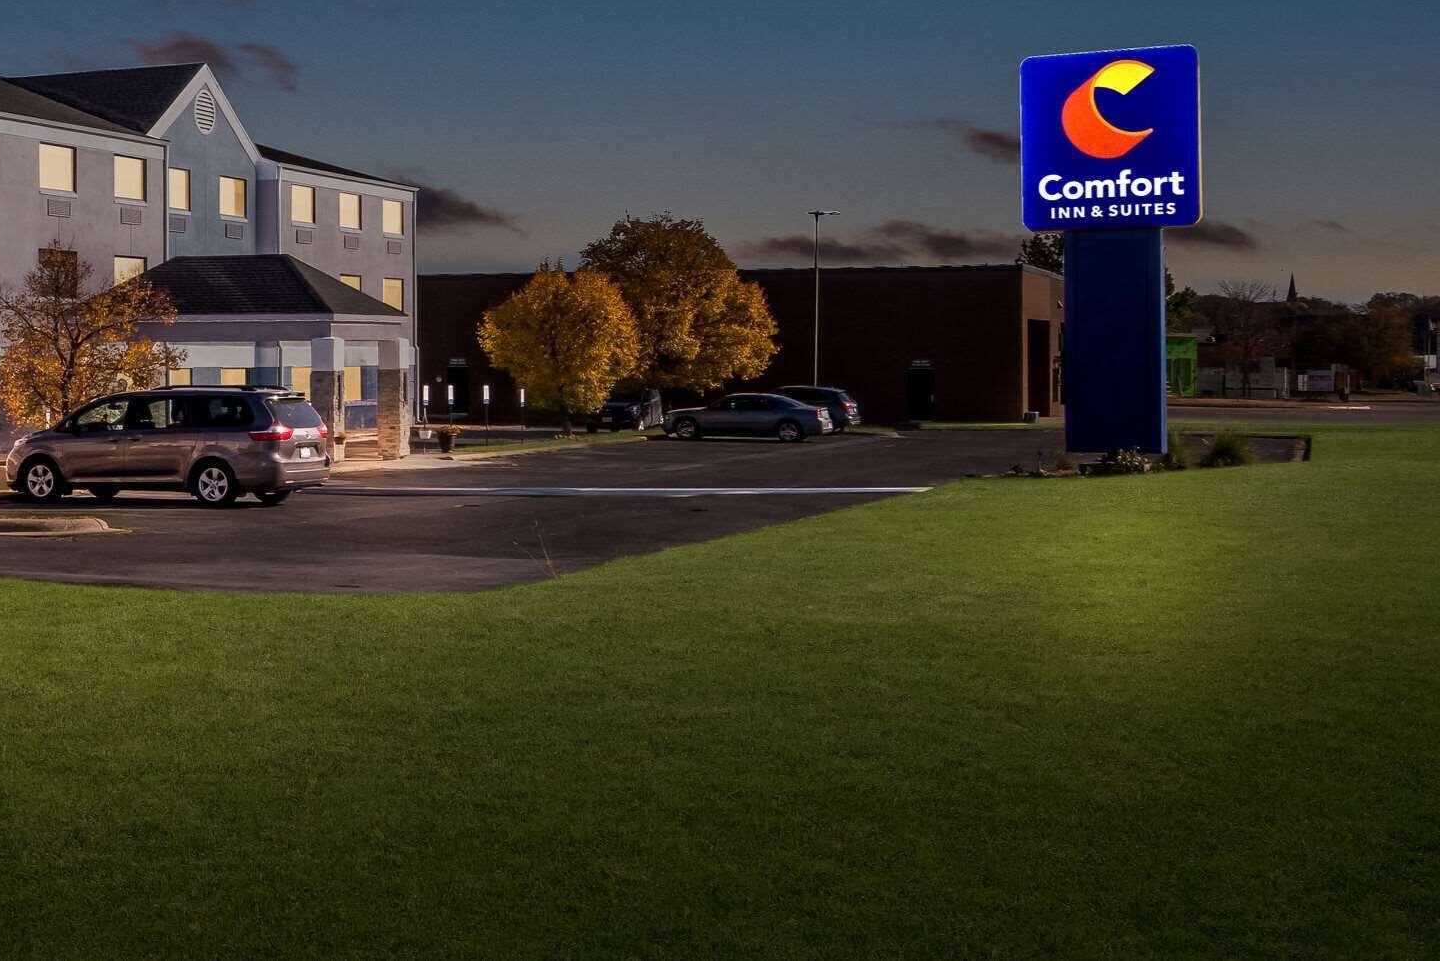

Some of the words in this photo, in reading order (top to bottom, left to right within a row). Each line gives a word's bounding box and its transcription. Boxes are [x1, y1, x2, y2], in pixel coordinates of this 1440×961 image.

[1038, 169, 1185, 201] Comfort
[1050, 206, 1086, 219] INN
[1090, 205, 1104, 218] &
[1108, 202, 1177, 217] SUITES
